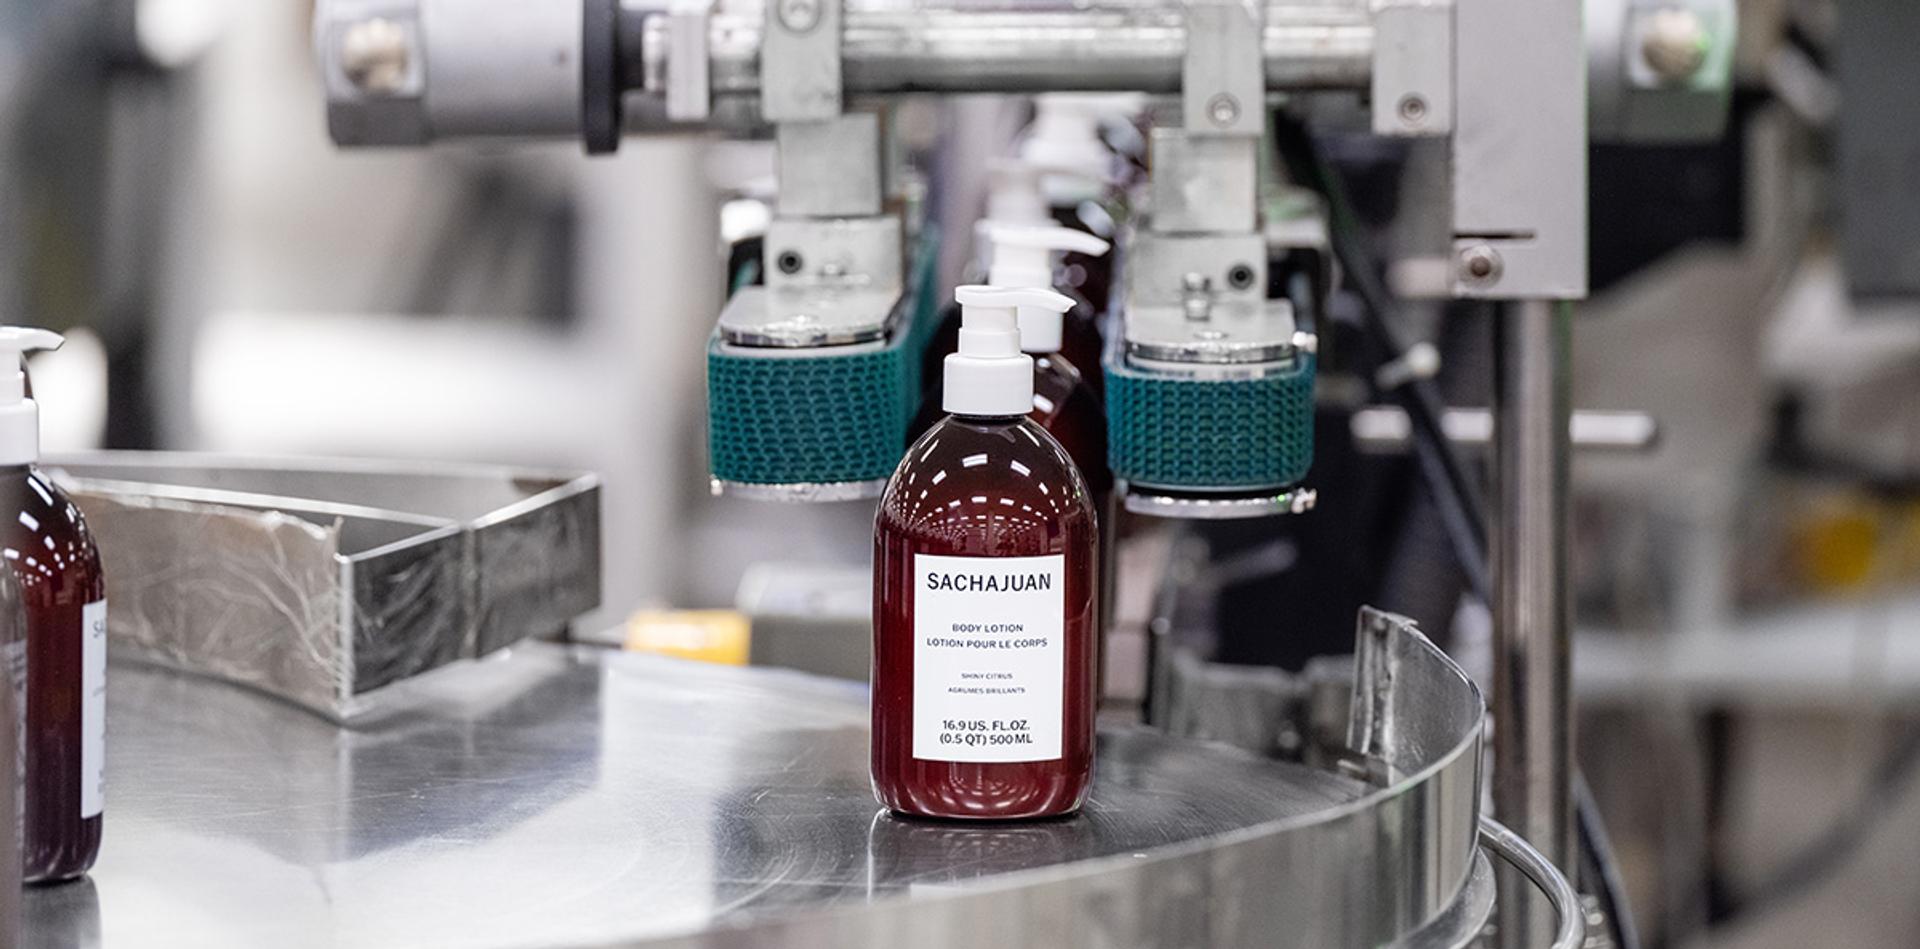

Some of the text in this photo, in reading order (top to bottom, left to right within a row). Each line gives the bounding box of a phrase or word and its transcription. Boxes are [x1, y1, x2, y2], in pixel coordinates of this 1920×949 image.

[927, 573, 1051, 591] SACHAJUAN
[952, 624, 1023, 633] BODY LOTION
[927, 638, 1048, 649] LOTION POUR LE CORPS
[943, 720, 1030, 731] 16.9 US. FL.OZ.
[940, 734, 1032, 746] (0.5 QT) 500 ML
